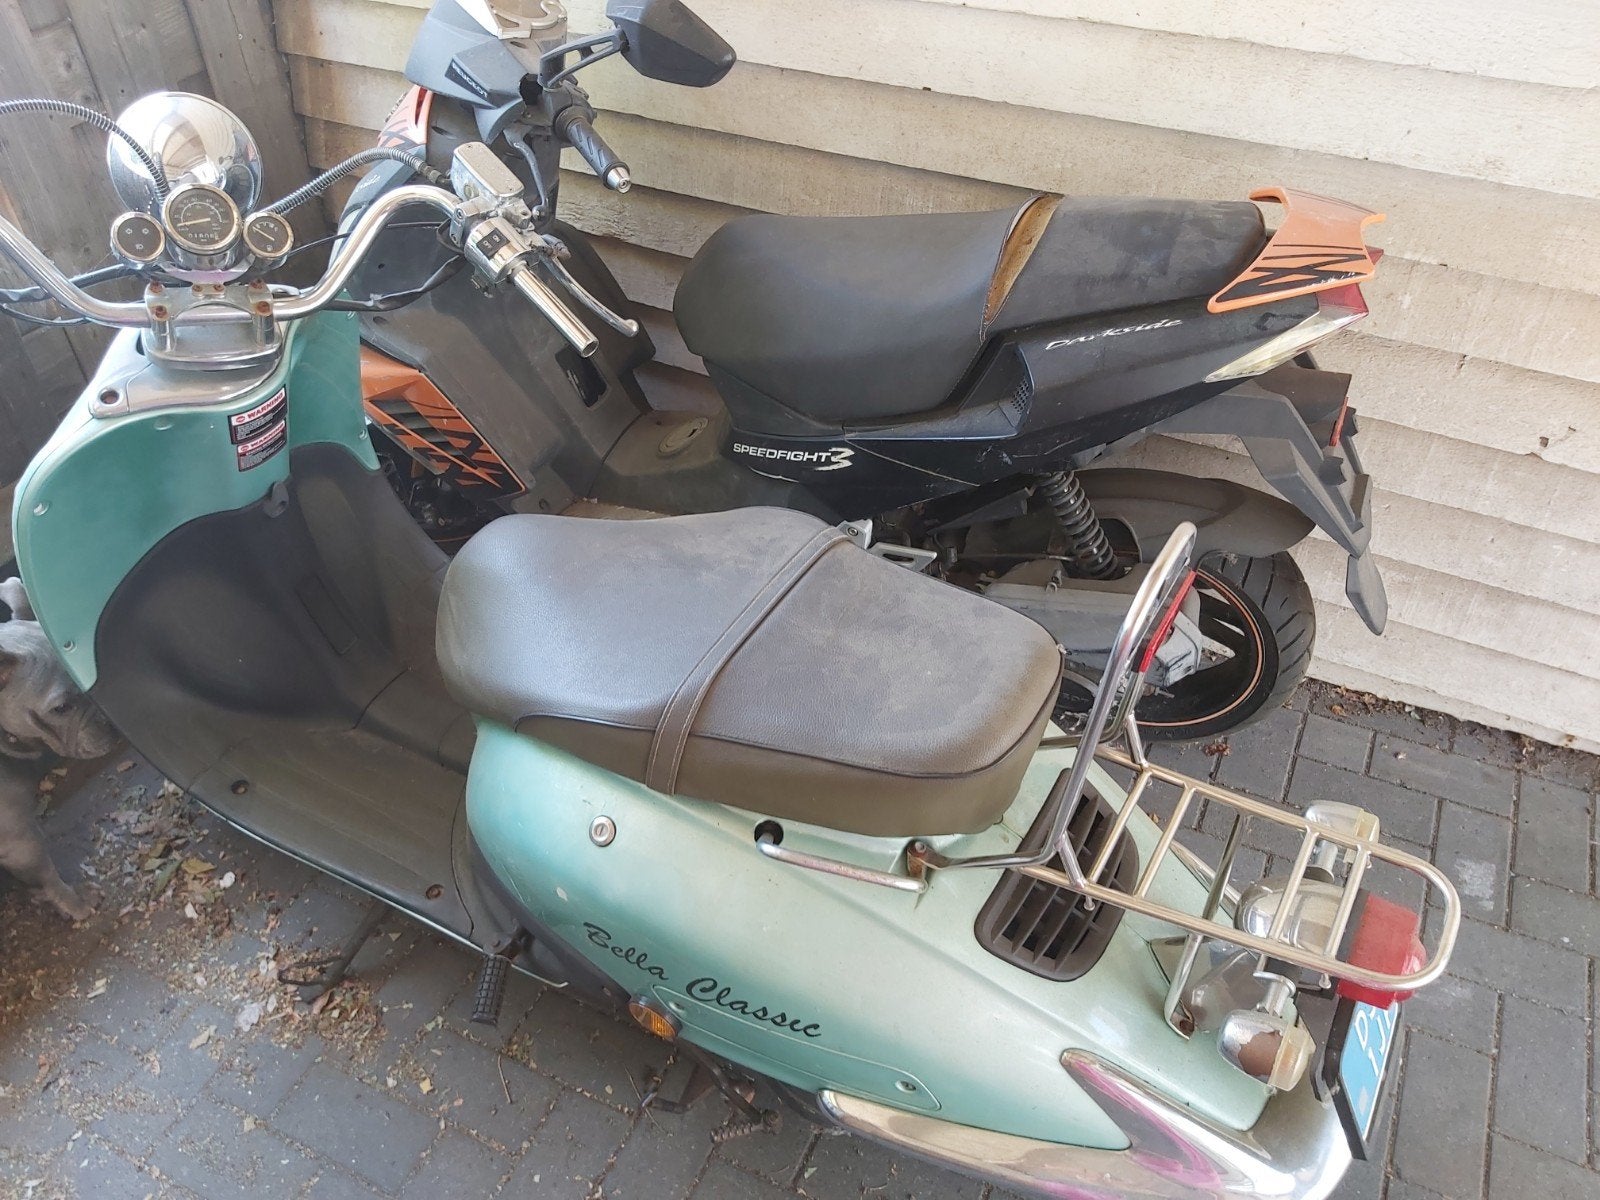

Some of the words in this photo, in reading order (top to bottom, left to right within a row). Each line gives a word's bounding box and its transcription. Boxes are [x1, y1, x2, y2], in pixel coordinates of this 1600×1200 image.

[247, 392, 284, 418] WARNING
[733, 443, 831, 462] SPEEDFIGHT
[815, 447, 855, 471] 3
[583, 921, 669, 981] Bella
[685, 977, 821, 1037] Classic
